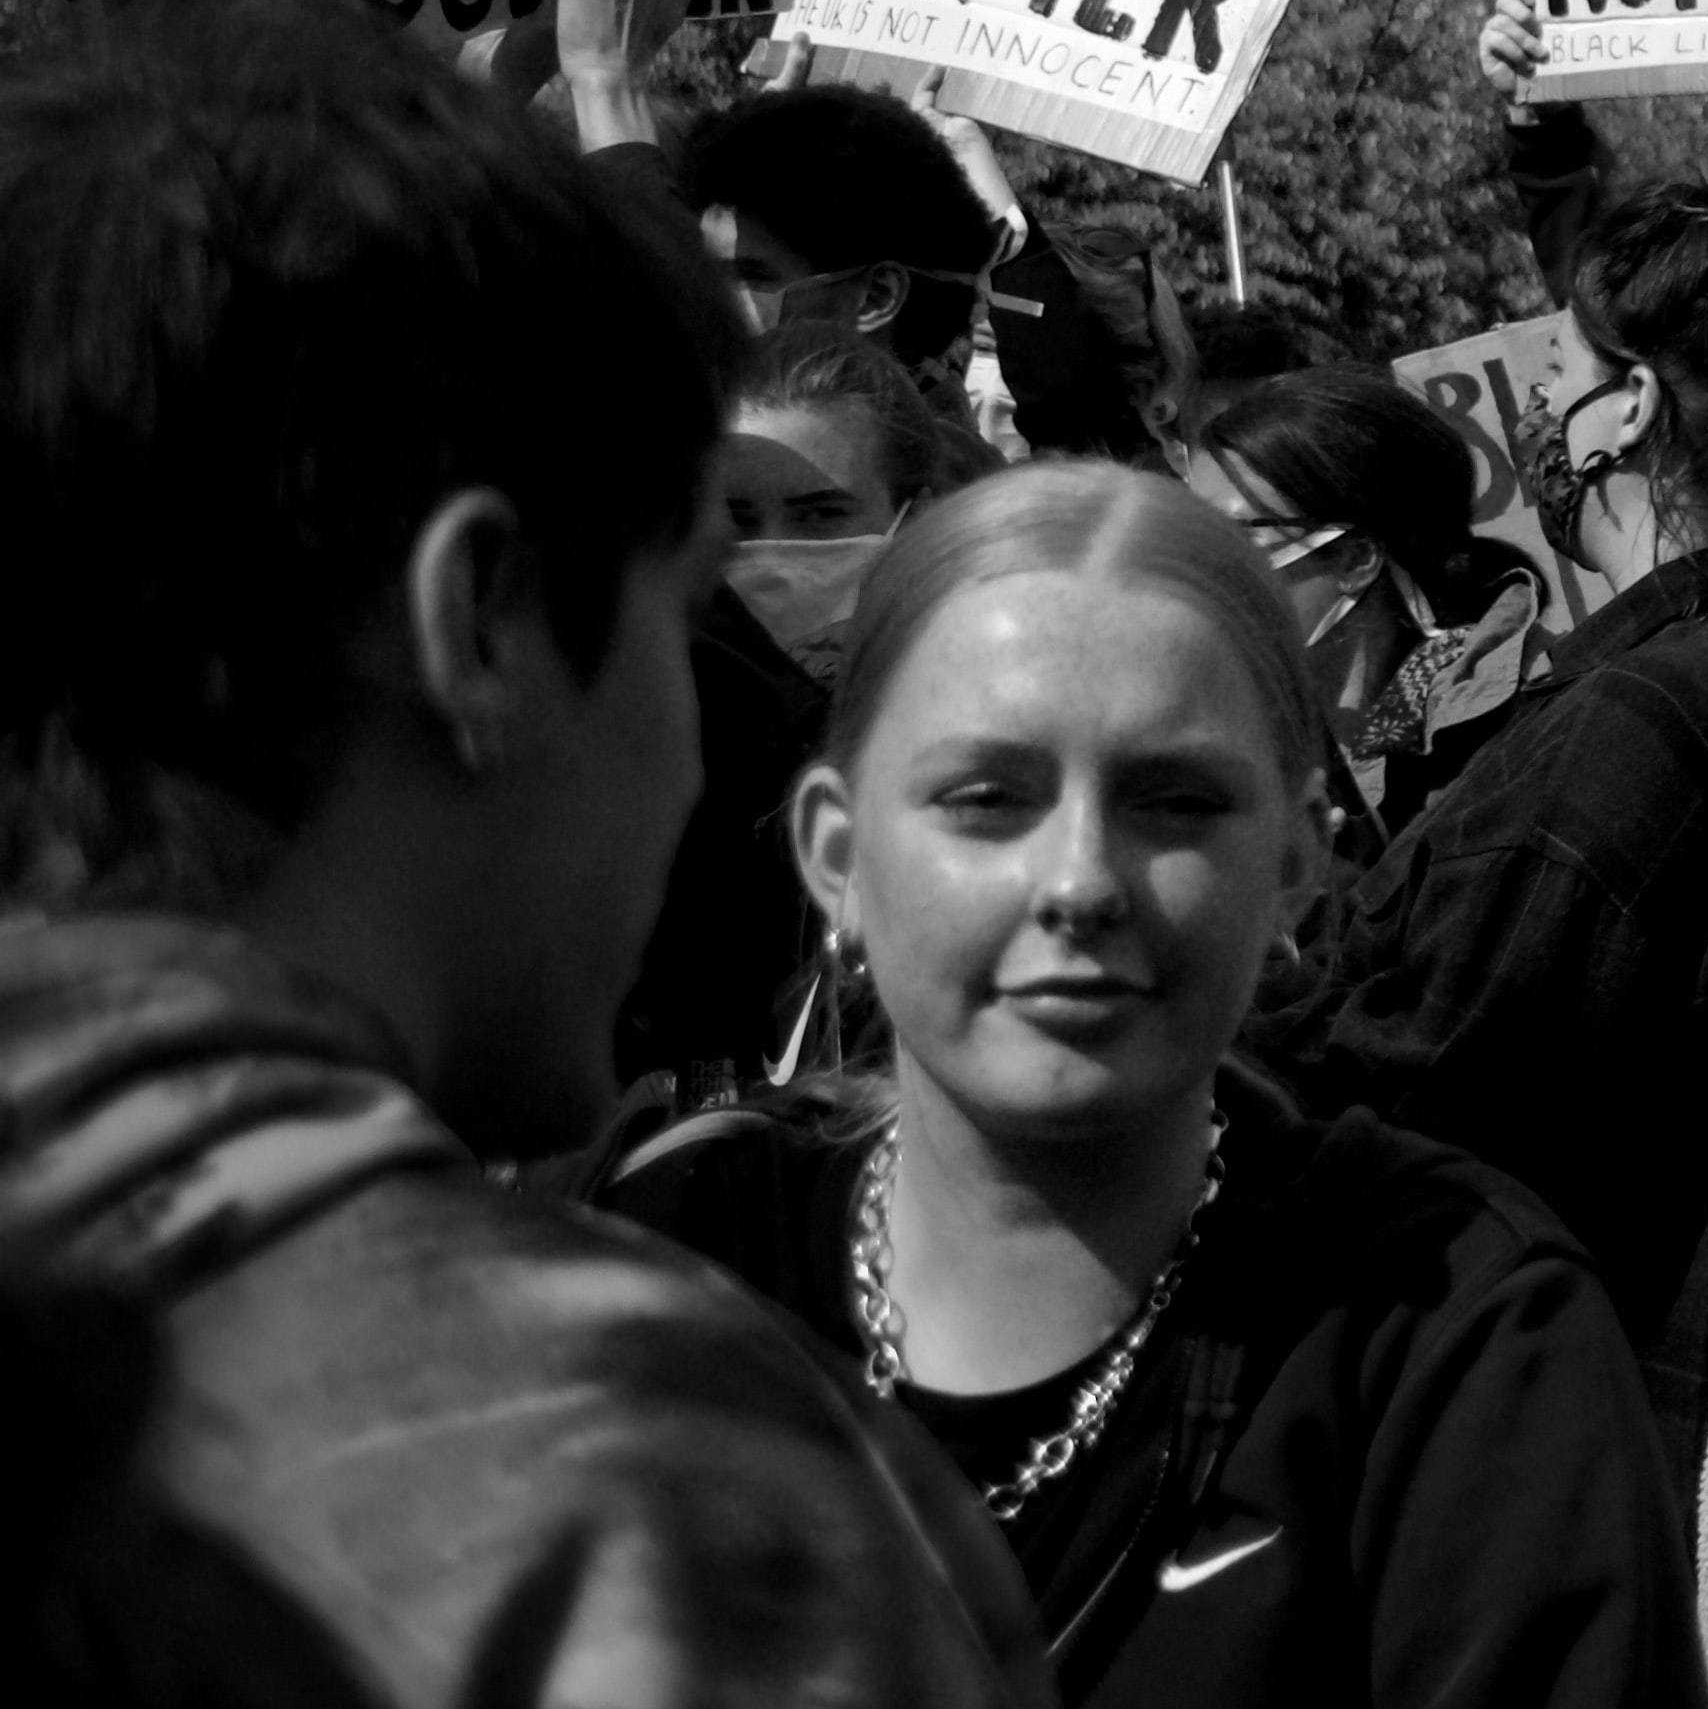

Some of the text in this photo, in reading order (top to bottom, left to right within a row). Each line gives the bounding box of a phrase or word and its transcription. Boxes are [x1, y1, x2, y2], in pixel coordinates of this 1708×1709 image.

[850, 0, 873, 34] IS
[878, 7, 938, 46] NOT
[957, 18, 1203, 115] INNOCENT.
[1552, 34, 1648, 63] BLACK
